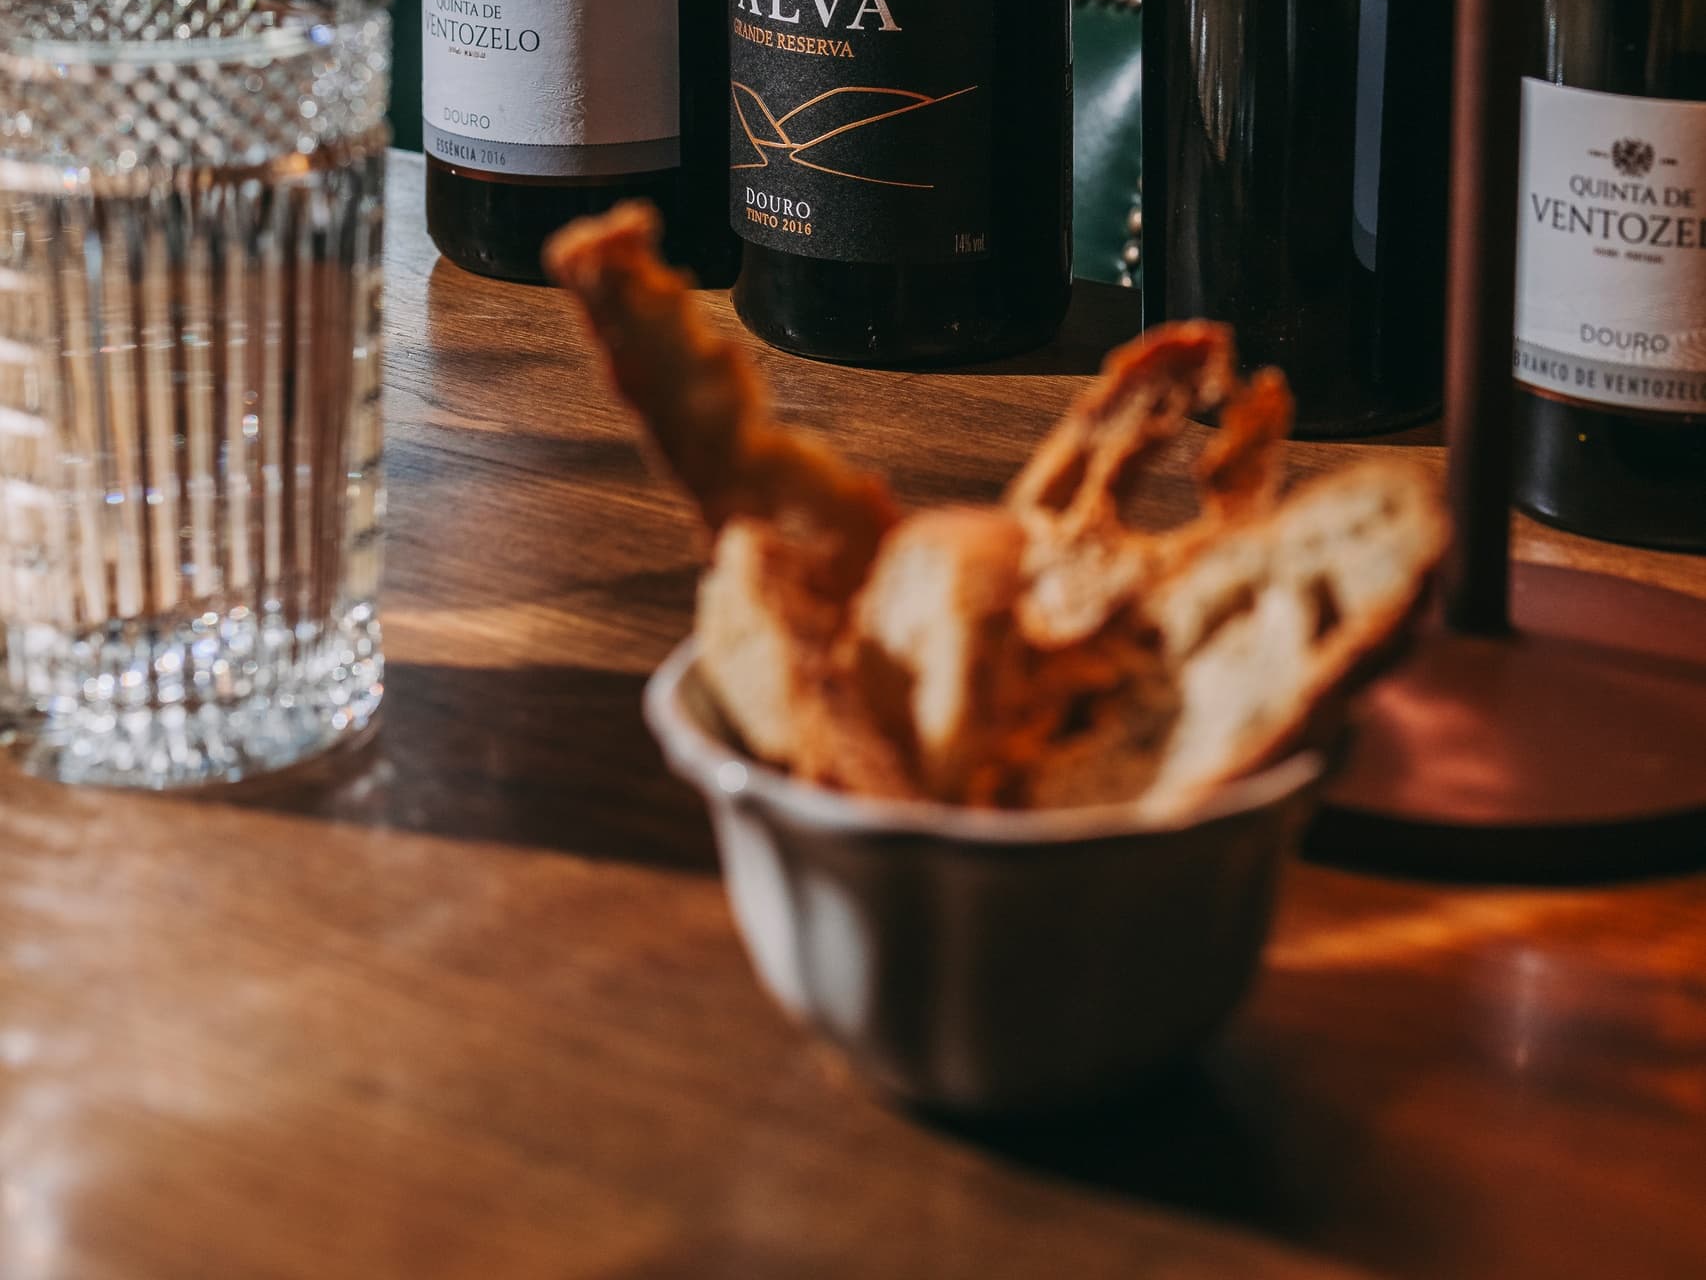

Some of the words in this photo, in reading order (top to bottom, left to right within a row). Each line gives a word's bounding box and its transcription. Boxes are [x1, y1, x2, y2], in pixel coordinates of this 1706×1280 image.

[482, 3, 502, 20] DE
[777, 31, 855, 58] RESERVA
[444, 107, 490, 129] DOURO
[481, 150, 506, 166] 2016
[745, 186, 811, 219] DOURO
[1569, 174, 1657, 206] QUINTA
[1663, 187, 1697, 208] DE
[746, 207, 778, 228] TINTO
[782, 218, 812, 236] 2016
[1580, 323, 1670, 353] DOURO
[1575, 366, 1596, 389] DE
